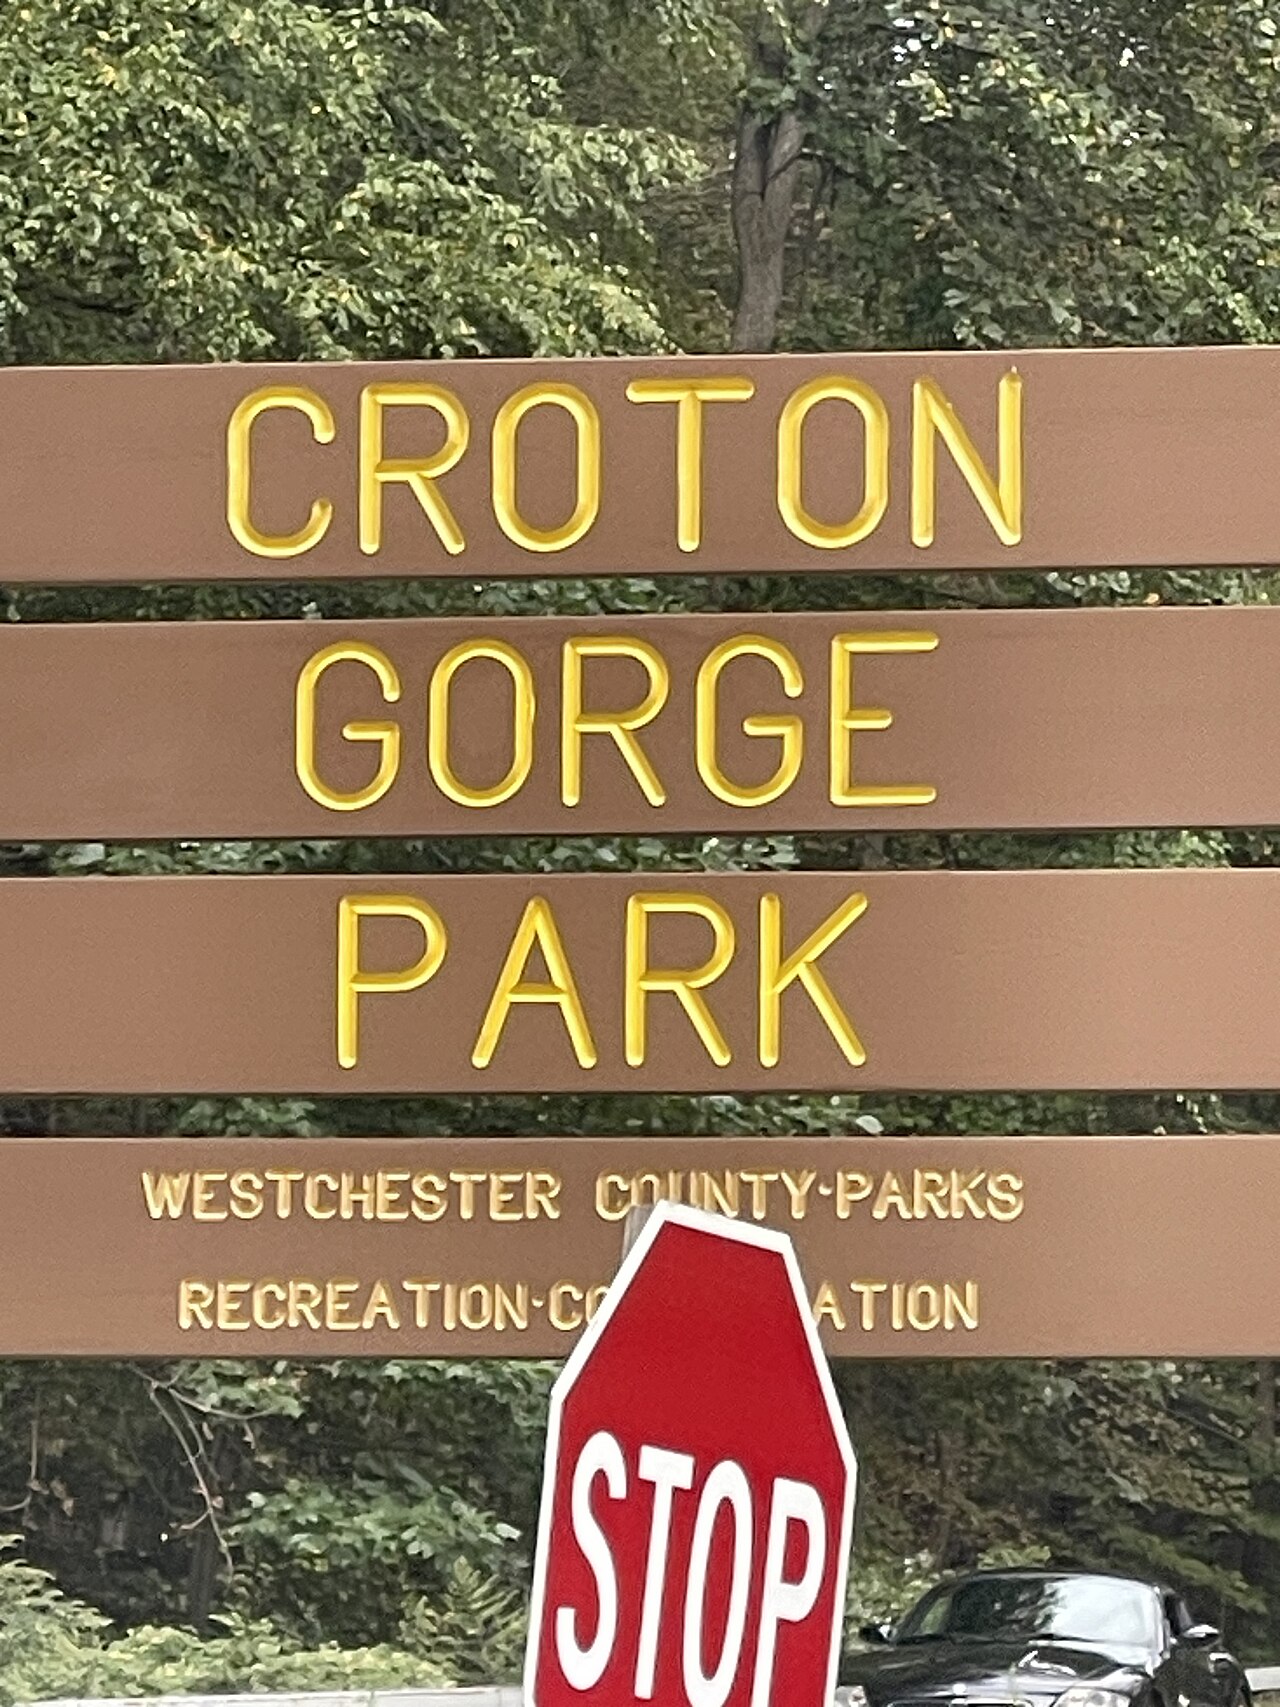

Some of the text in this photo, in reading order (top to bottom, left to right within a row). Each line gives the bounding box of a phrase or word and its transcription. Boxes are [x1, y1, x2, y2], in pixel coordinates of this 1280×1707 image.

[226, 366, 1024, 559] CROTON
[295, 633, 941, 812] GORGE
[336, 892, 868, 1069] PARK
[141, 1170, 562, 1221] WESTCHESTER
[555, 1430, 828, 1707] STOP
